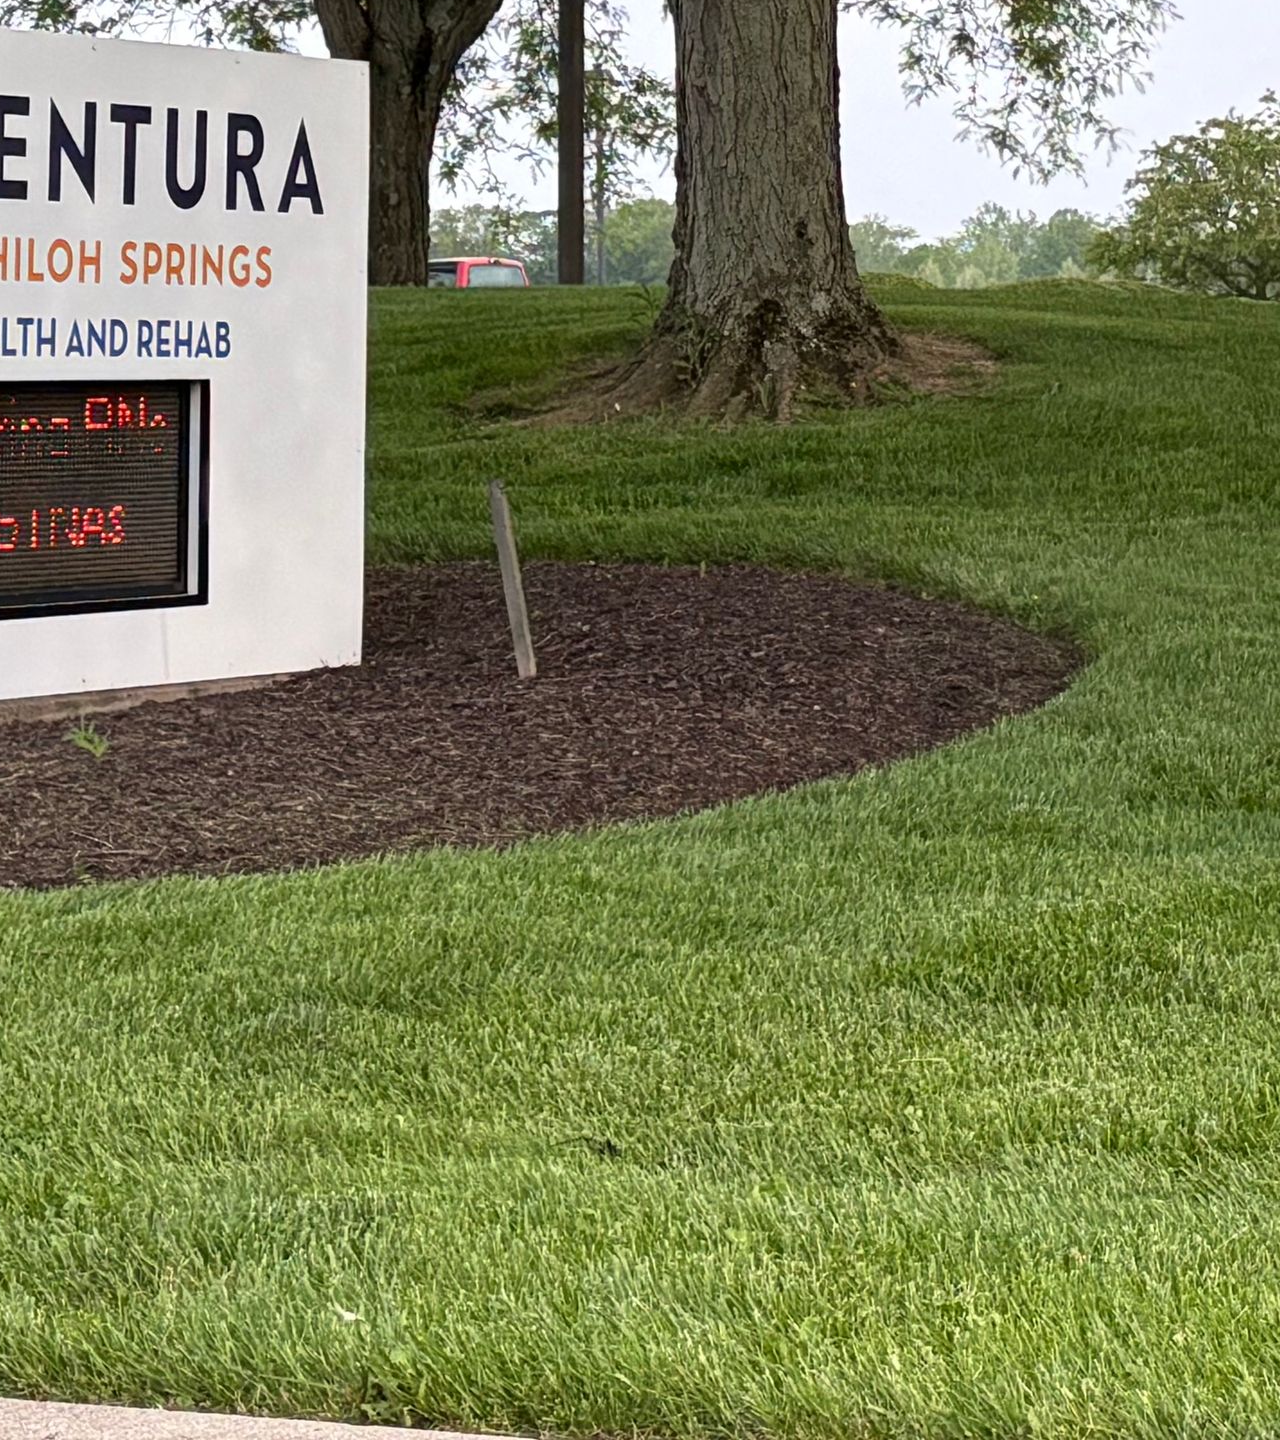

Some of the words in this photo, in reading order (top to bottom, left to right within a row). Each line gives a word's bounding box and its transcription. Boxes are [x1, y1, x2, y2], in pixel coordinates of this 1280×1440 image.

[120, 241, 272, 288] SPRINGS
[65, 318, 128, 358] AND
[137, 320, 231, 359] REHAB
